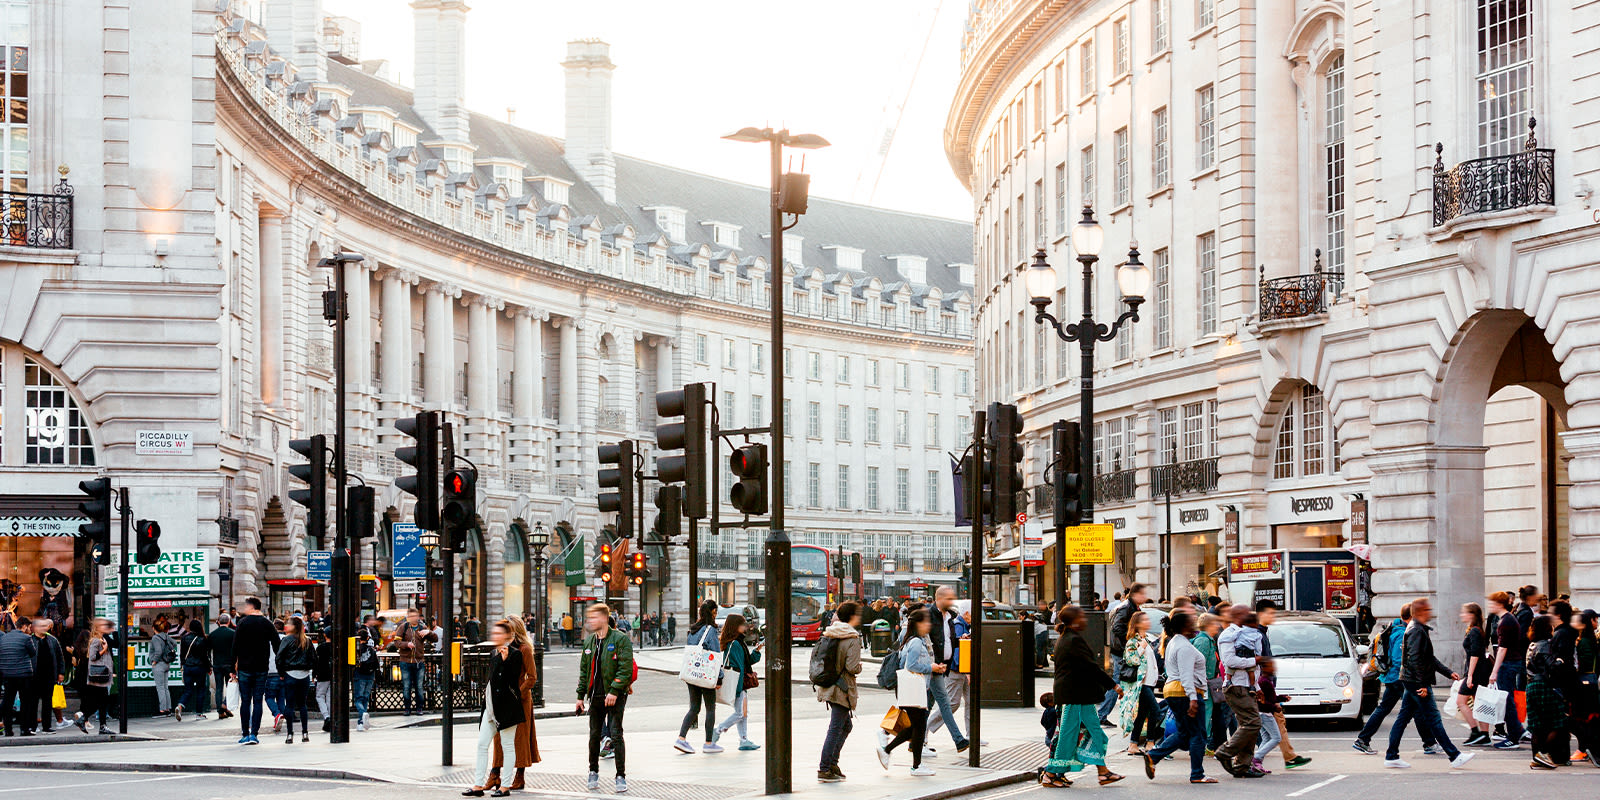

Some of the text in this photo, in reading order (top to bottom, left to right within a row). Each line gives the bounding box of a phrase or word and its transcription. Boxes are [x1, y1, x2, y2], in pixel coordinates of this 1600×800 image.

[1290, 496, 1334, 516] NESPRESSO
[1179, 508, 1209, 526] NESPRESSO
[128, 552, 205, 562] TATRE
[129, 564, 202, 574] TICKETS
[128, 578, 201, 587] ON SALE HERE
